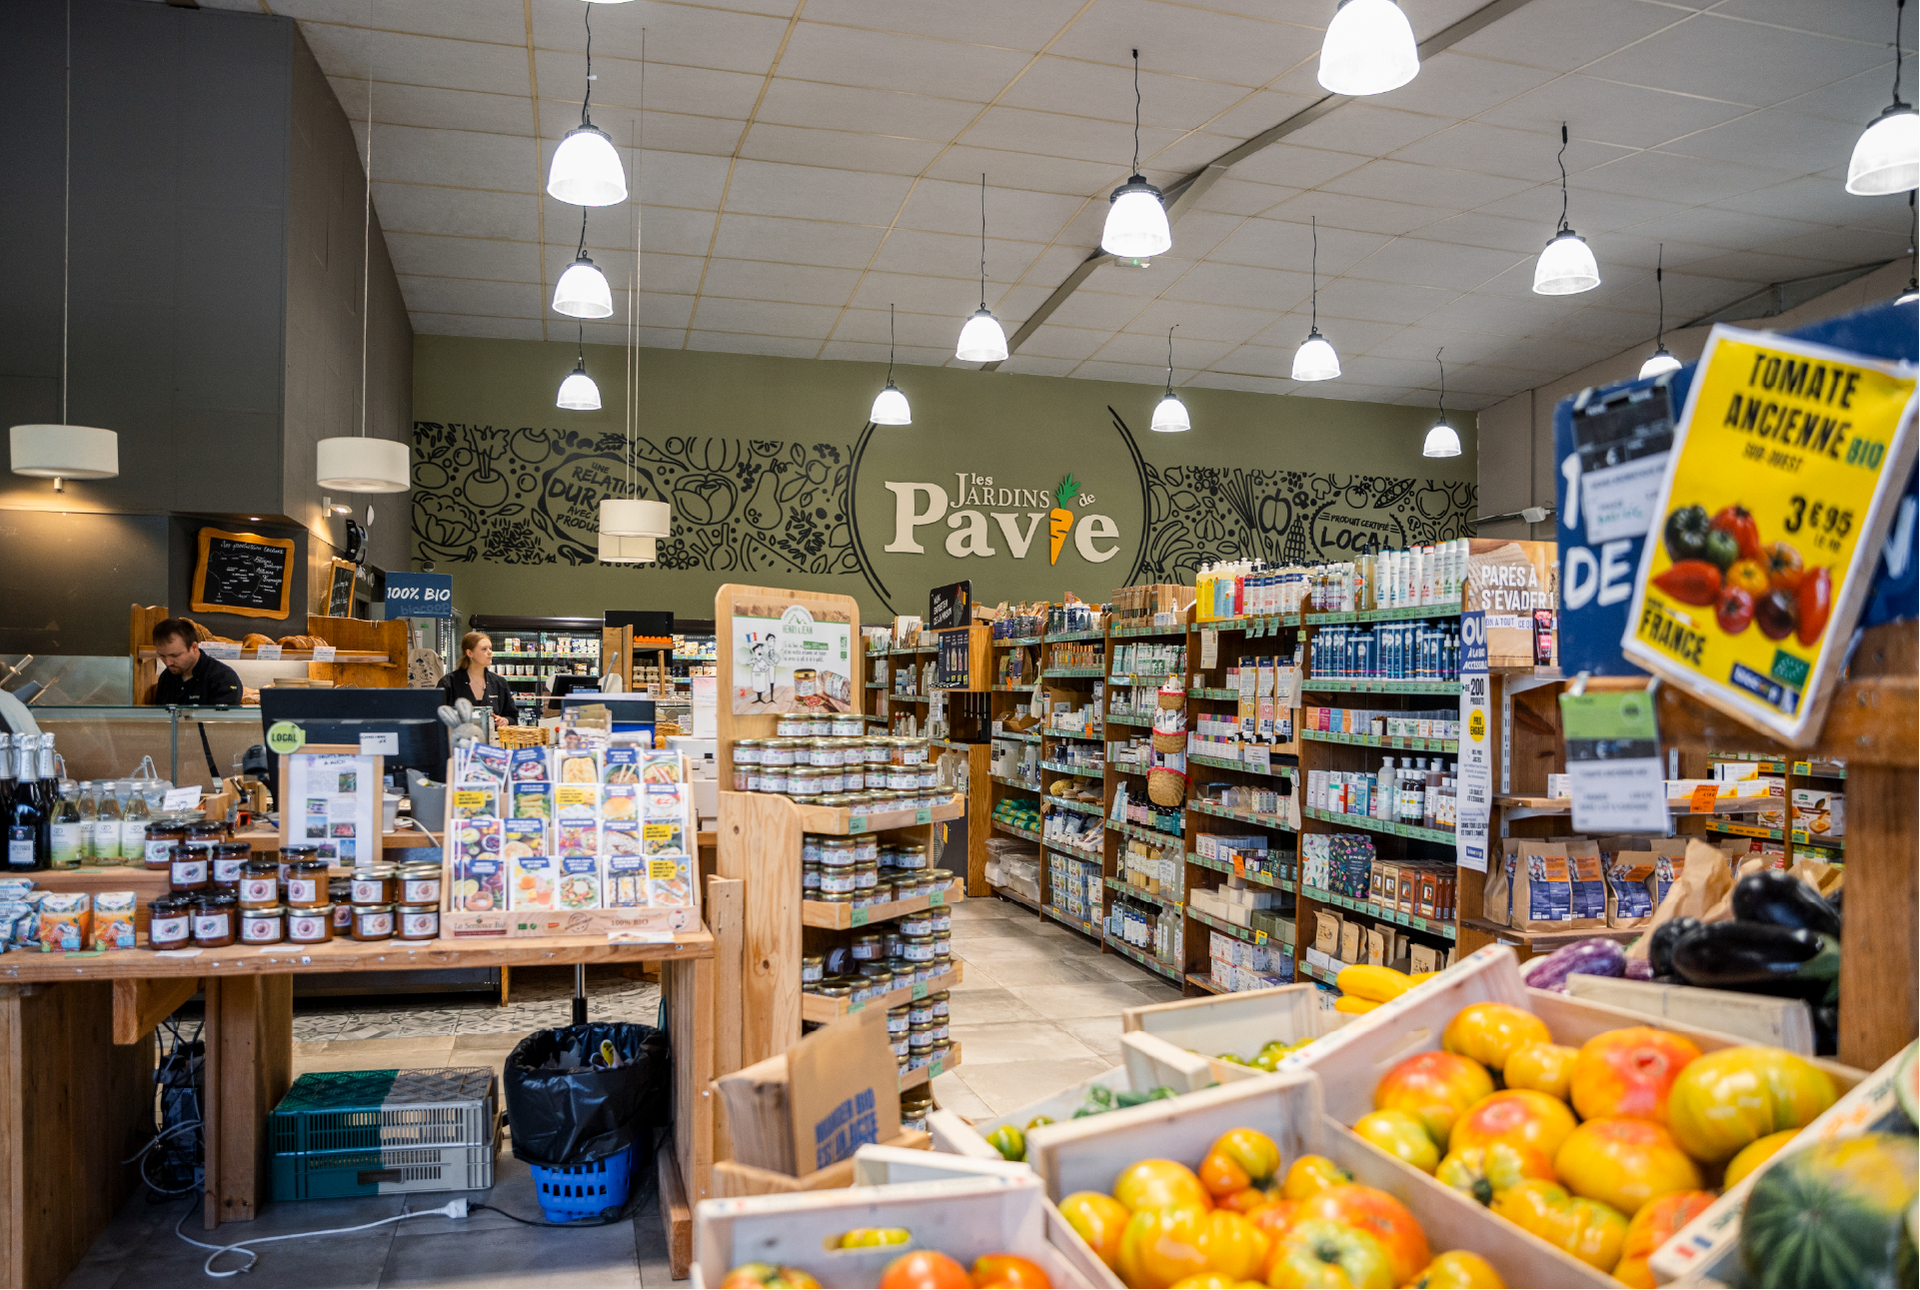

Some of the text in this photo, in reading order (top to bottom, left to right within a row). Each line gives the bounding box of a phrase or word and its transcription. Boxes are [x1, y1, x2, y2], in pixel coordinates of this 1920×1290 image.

[1748, 353, 1860, 409] TOMATE
[1723, 394, 1852, 460] ANCIENNE
[1845, 436, 1885, 471] BIO
[591, 462, 610, 474] UNE
[572, 466, 648, 498] RELATION
[971, 473, 993, 486] les
[950, 473, 1096, 508] JARDINS de
[567, 506, 592, 519] AVEC
[1330, 515, 1390, 531] PRODUIT CERTIFIÉ
[1481, 563, 1538, 588] PARÉS À
[387, 587, 451, 601] 100% BIO
[1500, 617, 1515, 626] TOUT
[801, 625, 813, 635] JEAN
[1639, 610, 1706, 666] FRANCE
[1471, 677, 1484, 696] 200
[271, 733, 298, 743] LOCAL
